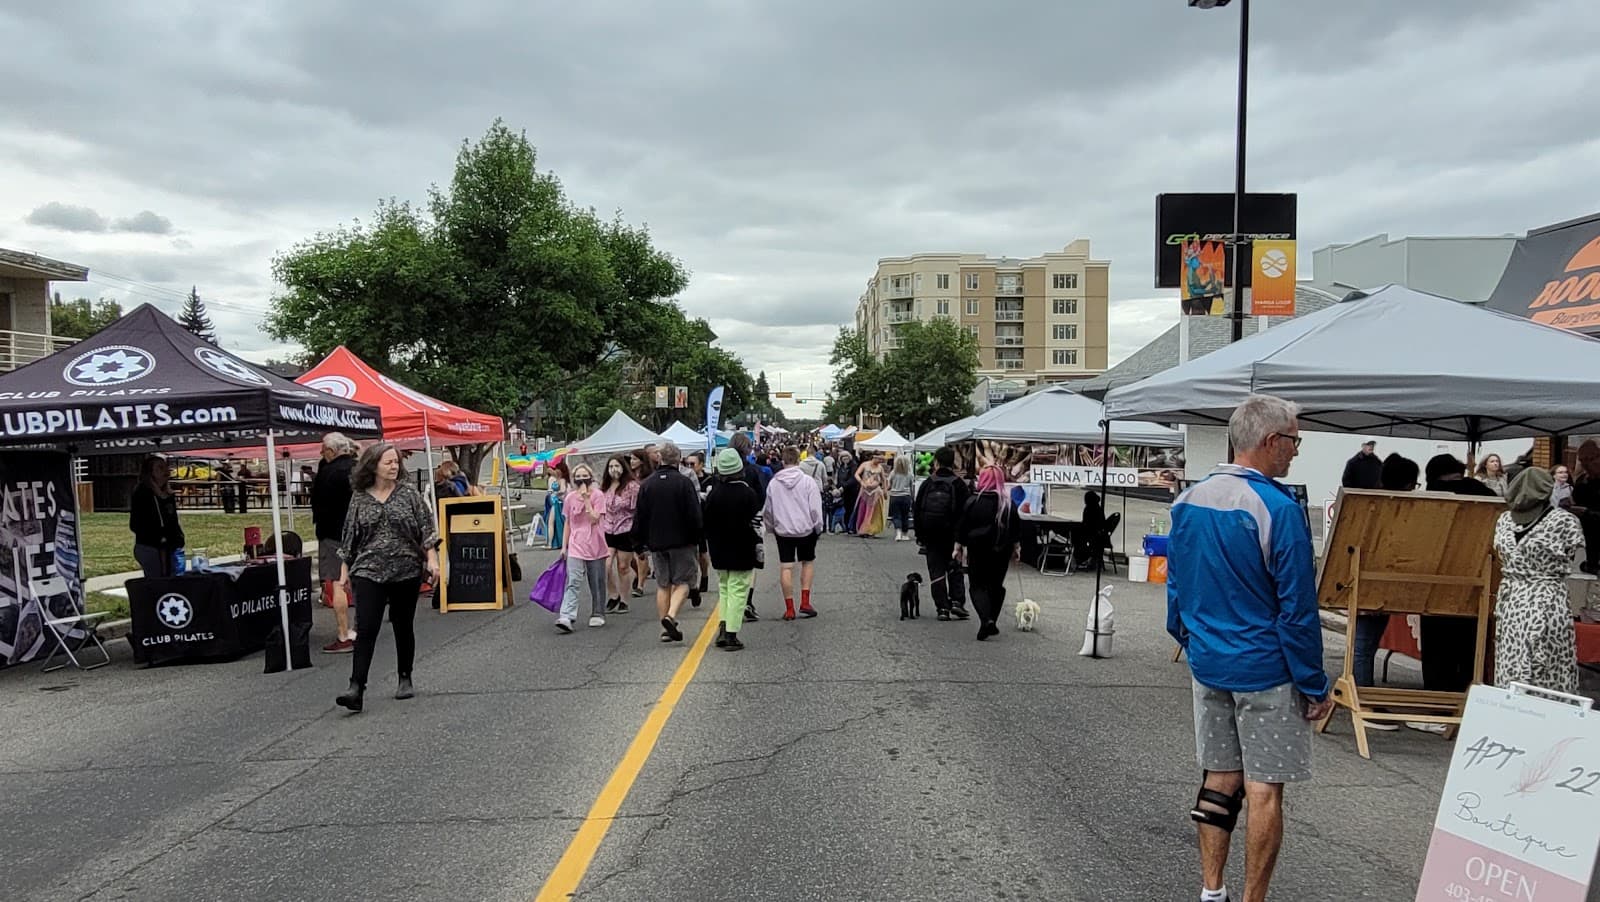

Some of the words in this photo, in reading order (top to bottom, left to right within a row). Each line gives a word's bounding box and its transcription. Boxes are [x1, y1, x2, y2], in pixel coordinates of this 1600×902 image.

[0, 391, 61, 400] CLUB
[70, 387, 172, 398] PILATES
[1033, 468, 1081, 483] HENNA
[1084, 469, 1136, 485] TATOO
[462, 546, 488, 560] FREE
[142, 634, 171, 647] CLUB
[174, 631, 215, 643] PILATES
[1464, 736, 1525, 770] APT
[1555, 766, 1600, 796] 22
[1454, 791, 1577, 859] Boutique
[1465, 856, 1537, 902] OPEN
